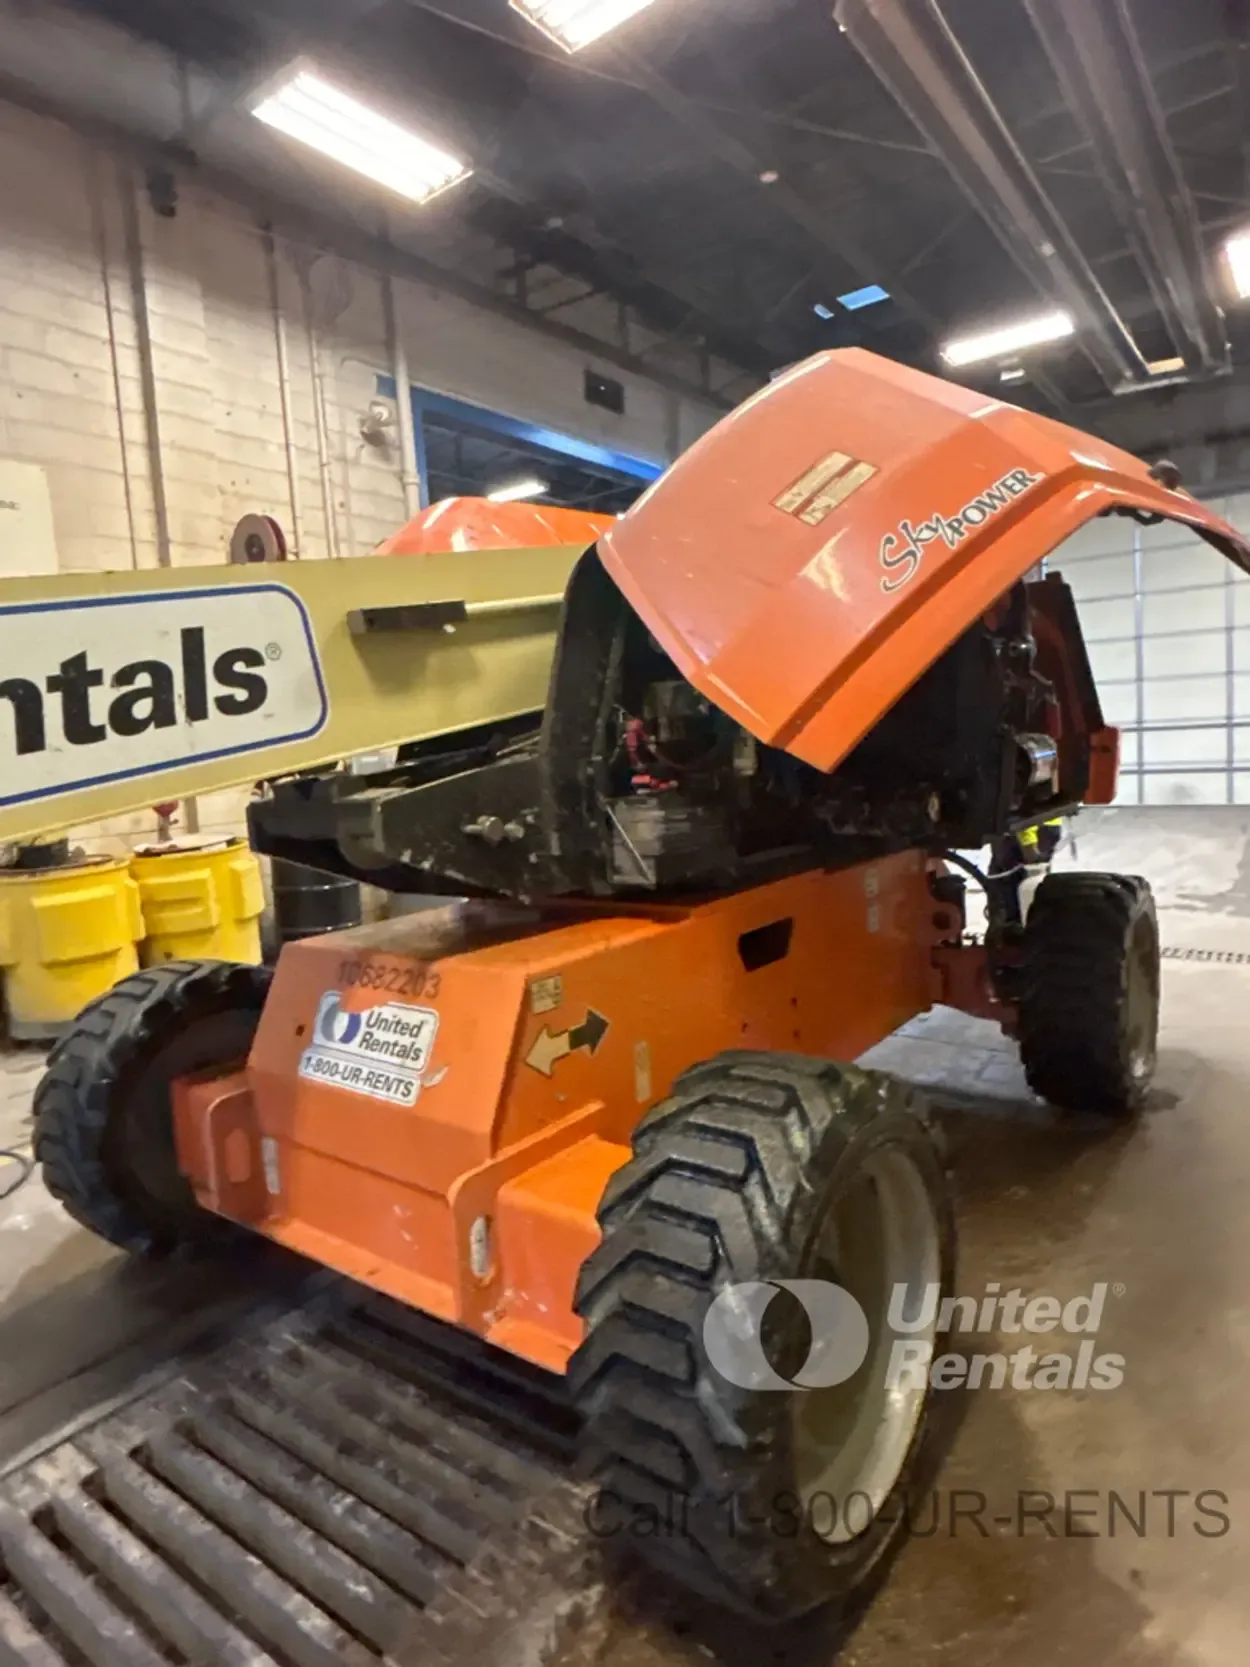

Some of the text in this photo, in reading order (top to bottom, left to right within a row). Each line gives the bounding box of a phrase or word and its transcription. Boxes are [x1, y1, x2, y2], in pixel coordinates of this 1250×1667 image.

[365, 1010, 424, 1038] United
[358, 1031, 423, 1062] Rentals
[304, 1056, 414, 1098] 1-800-UR-RENTS
